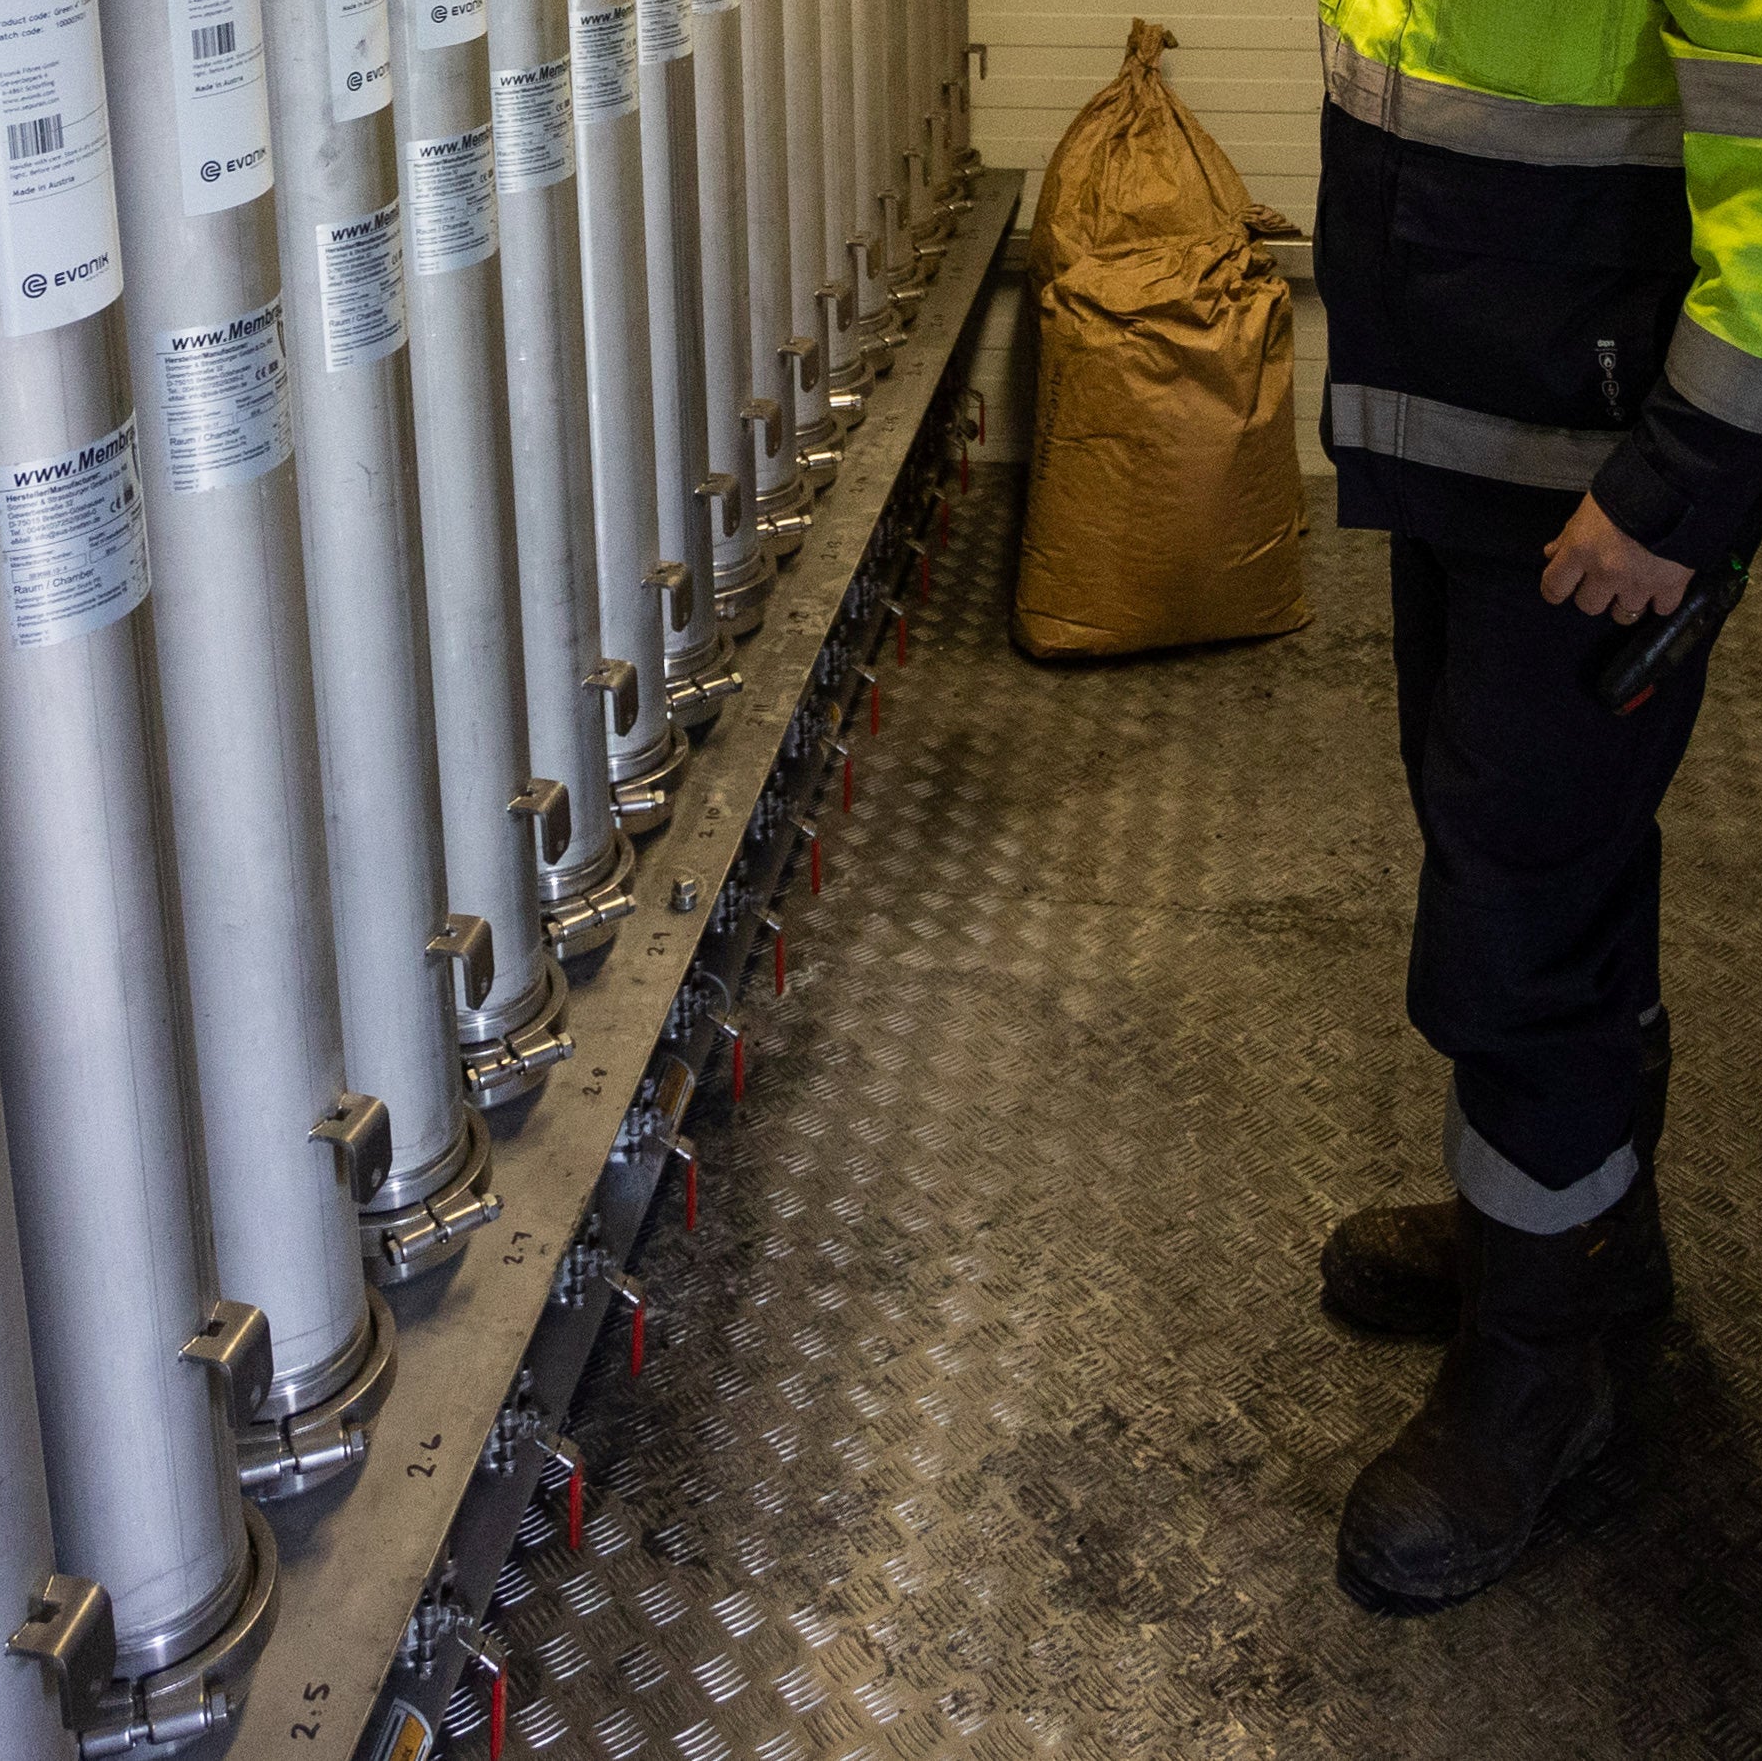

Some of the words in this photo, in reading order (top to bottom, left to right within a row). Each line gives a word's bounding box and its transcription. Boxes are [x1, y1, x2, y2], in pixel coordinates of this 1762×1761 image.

[29, 12, 51, 22] code:
[21, 26, 44, 37] code:
[13, 186, 35, 197] Made
[38, 184, 47, 192] in
[48, 176, 75, 189] Austria
[13, 584, 44, 595] Raum
[52, 568, 94, 587] Chamber
[582, 1067, 608, 1097] 2.8
[503, 1231, 532, 1266] 2.7
[406, 1433, 443, 1478] 2.6
[291, 1682, 330, 1740] 2.5
